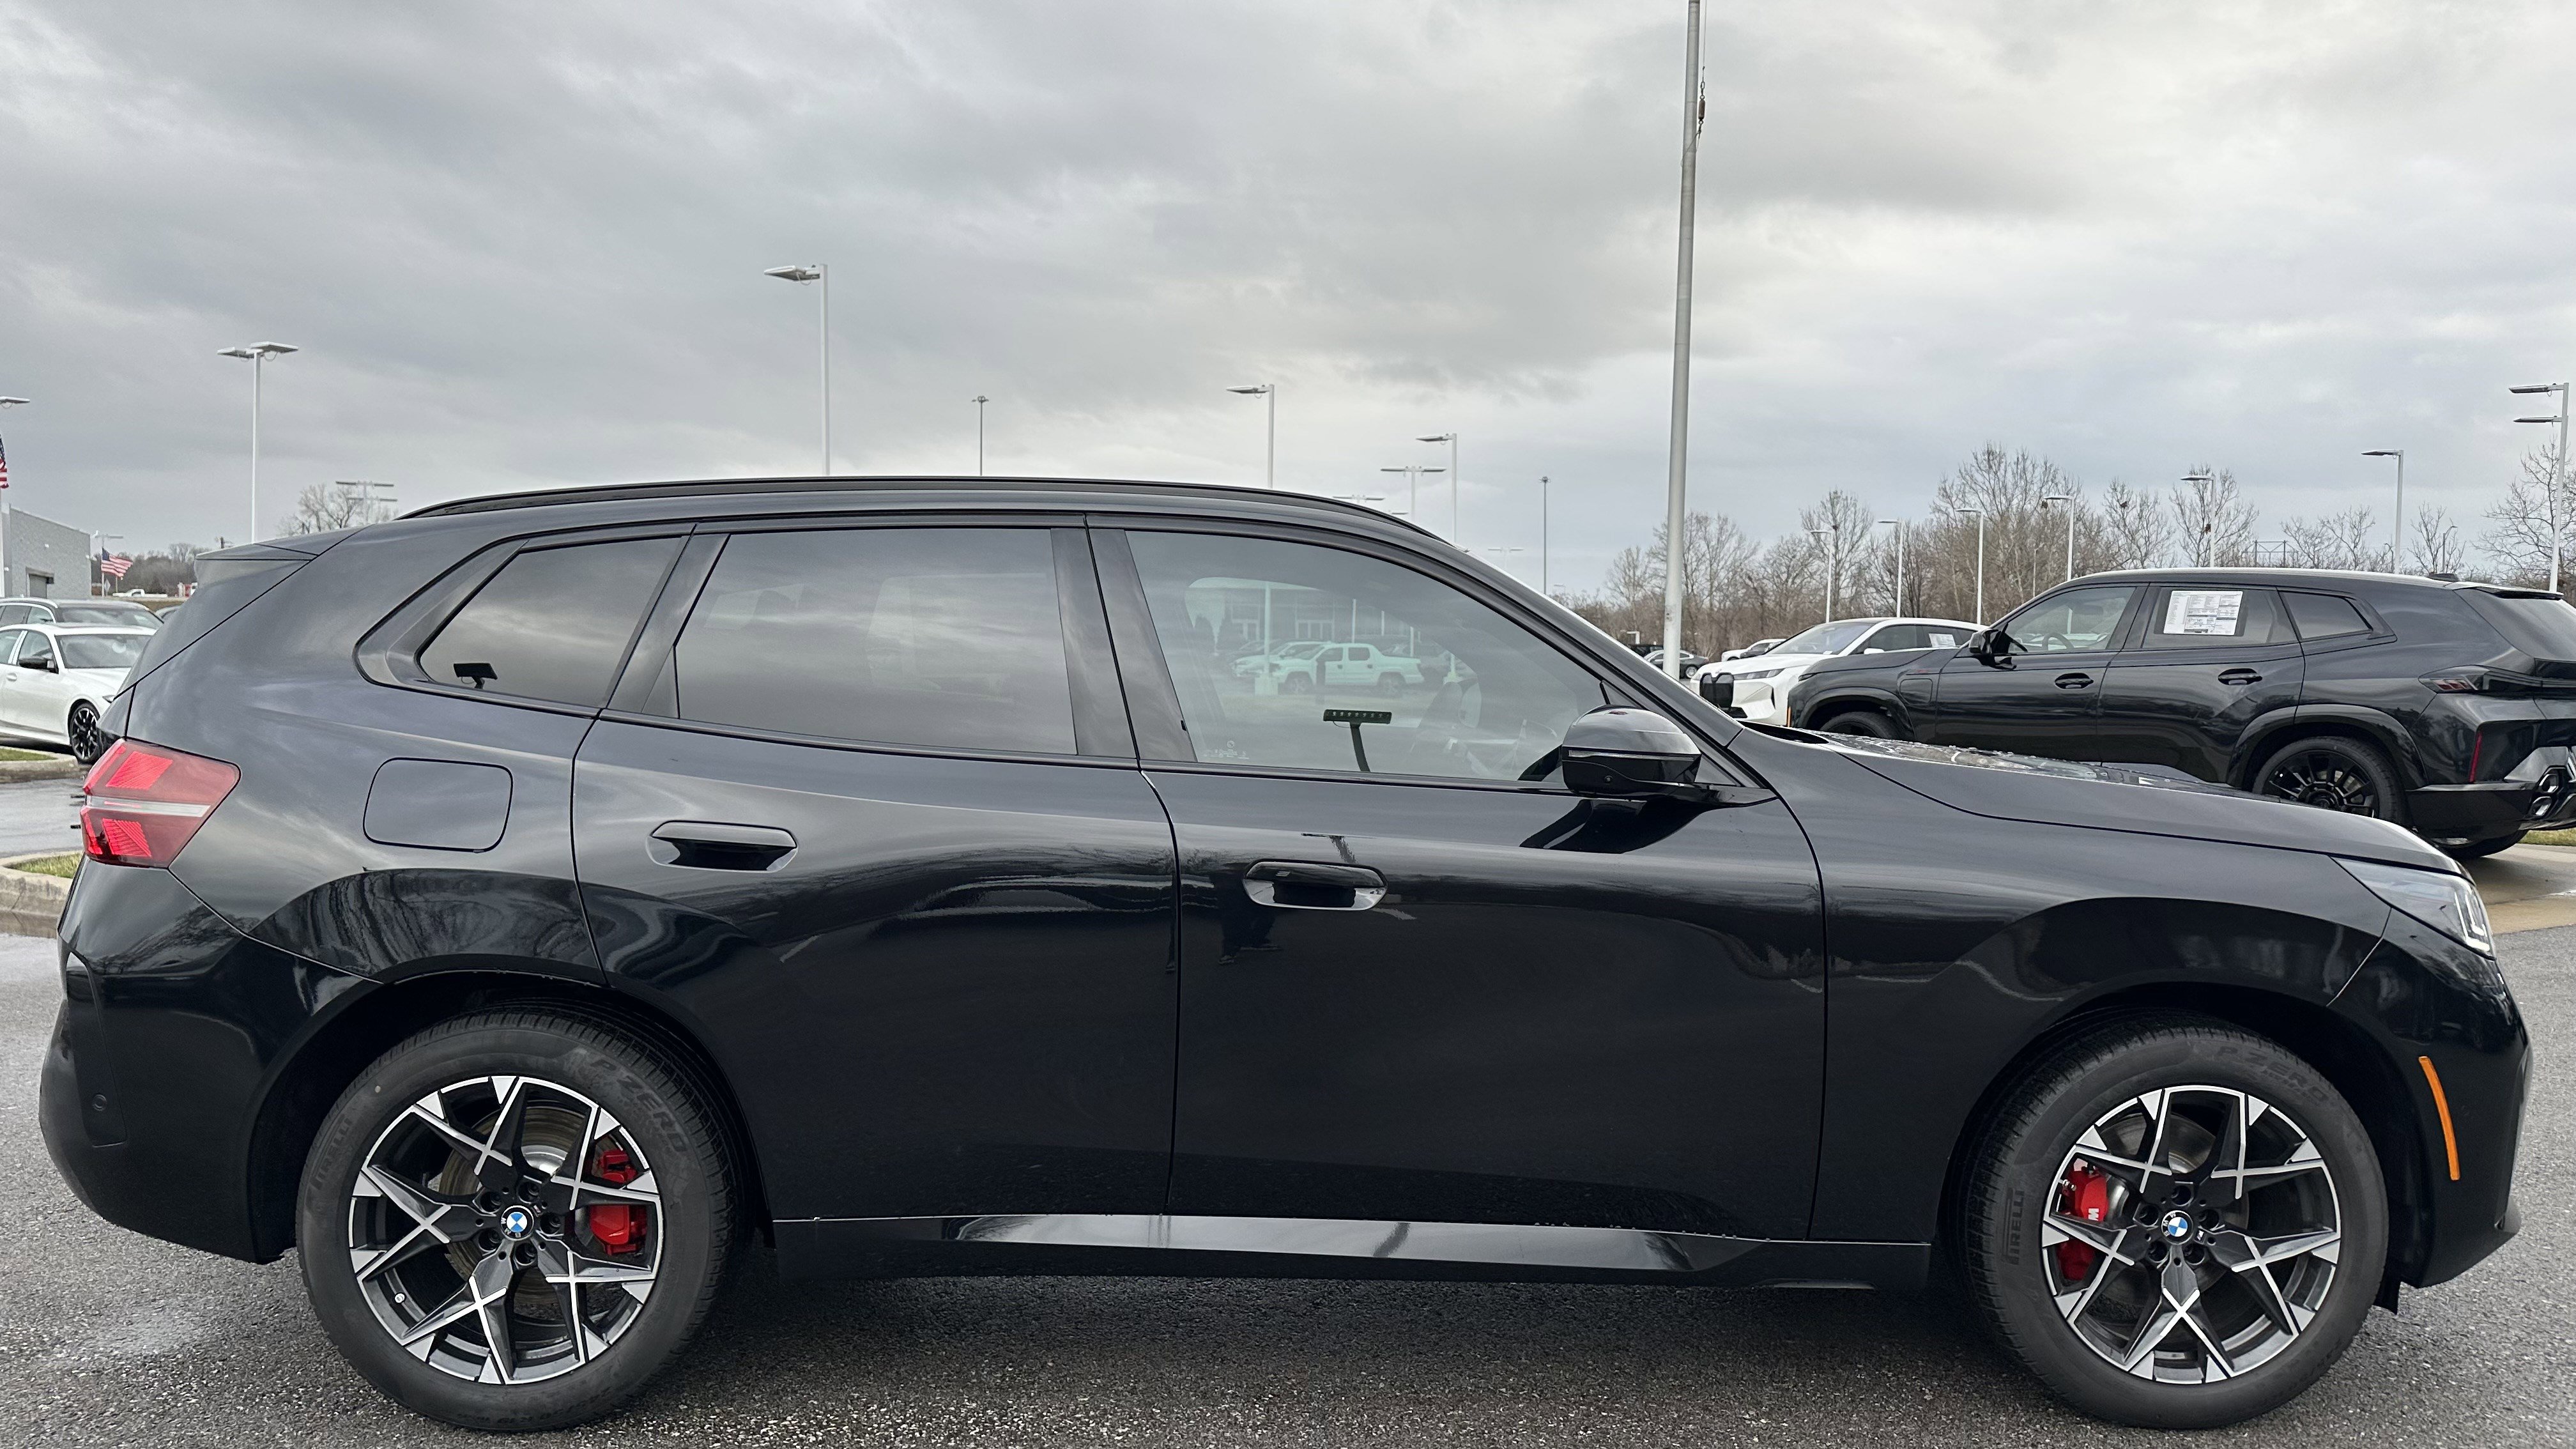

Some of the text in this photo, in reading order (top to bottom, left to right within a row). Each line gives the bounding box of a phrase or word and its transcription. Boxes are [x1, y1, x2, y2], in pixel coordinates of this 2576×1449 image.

[309, 1113, 353, 1190] PIRELLI
[617, 1076, 687, 1153] ZERO
[2001, 1187, 2025, 1265] PIRELLI
